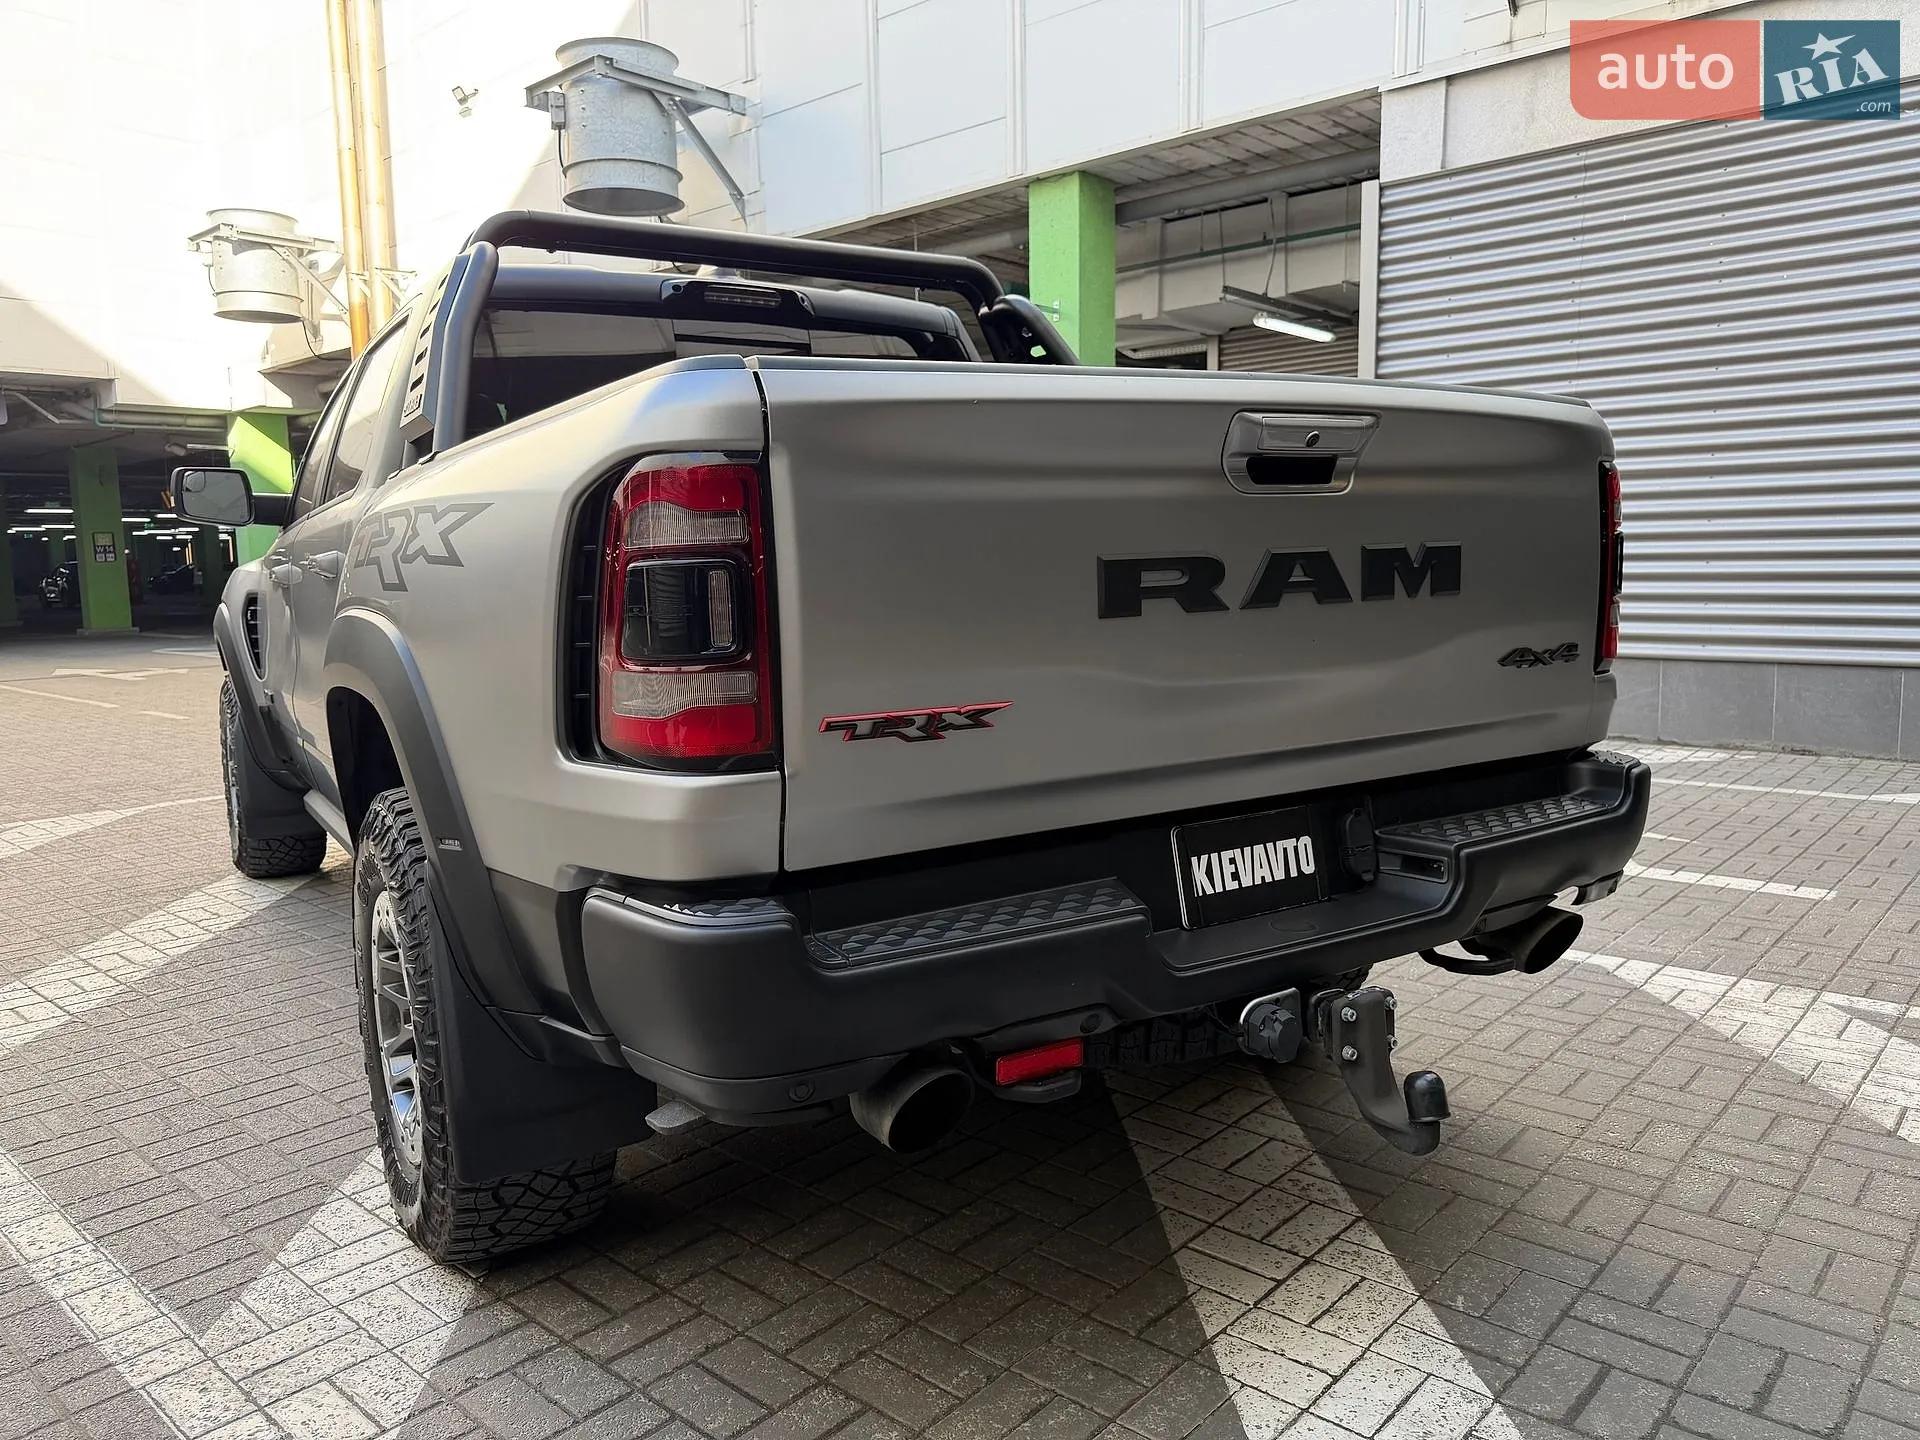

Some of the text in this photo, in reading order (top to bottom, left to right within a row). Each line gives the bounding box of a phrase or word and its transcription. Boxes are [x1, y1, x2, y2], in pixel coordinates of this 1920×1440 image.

[353, 502, 495, 592] TRX
[1097, 540, 1462, 619] RAM
[818, 700, 1014, 743] TRX
[1191, 835, 1316, 897] KIEVAVTO
